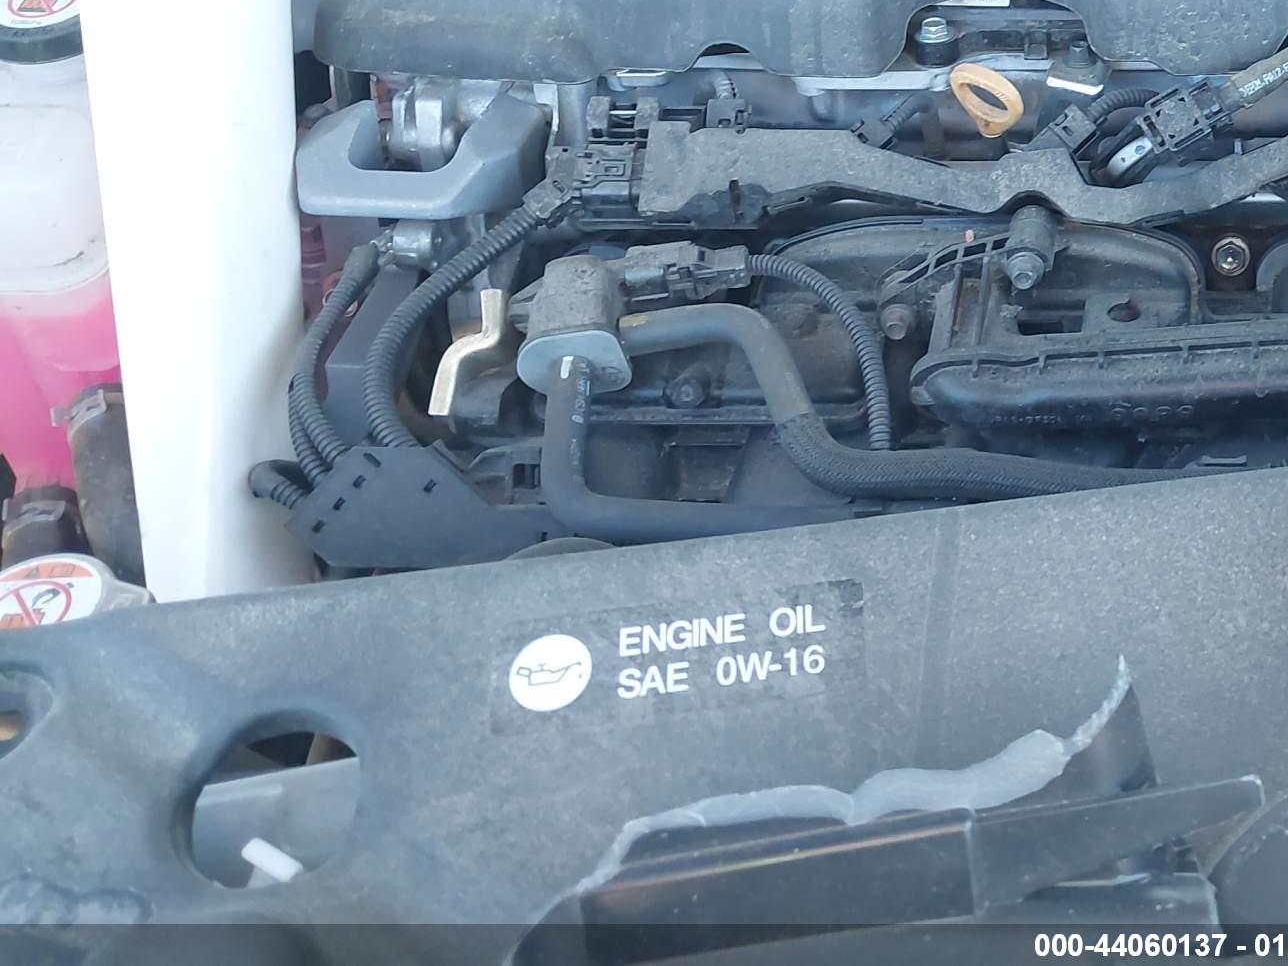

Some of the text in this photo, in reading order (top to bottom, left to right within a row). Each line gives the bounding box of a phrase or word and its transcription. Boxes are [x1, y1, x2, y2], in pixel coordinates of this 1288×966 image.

[619, 604, 826, 657] ENGINE OIL
[616, 645, 826, 700] SAE 0W-16
